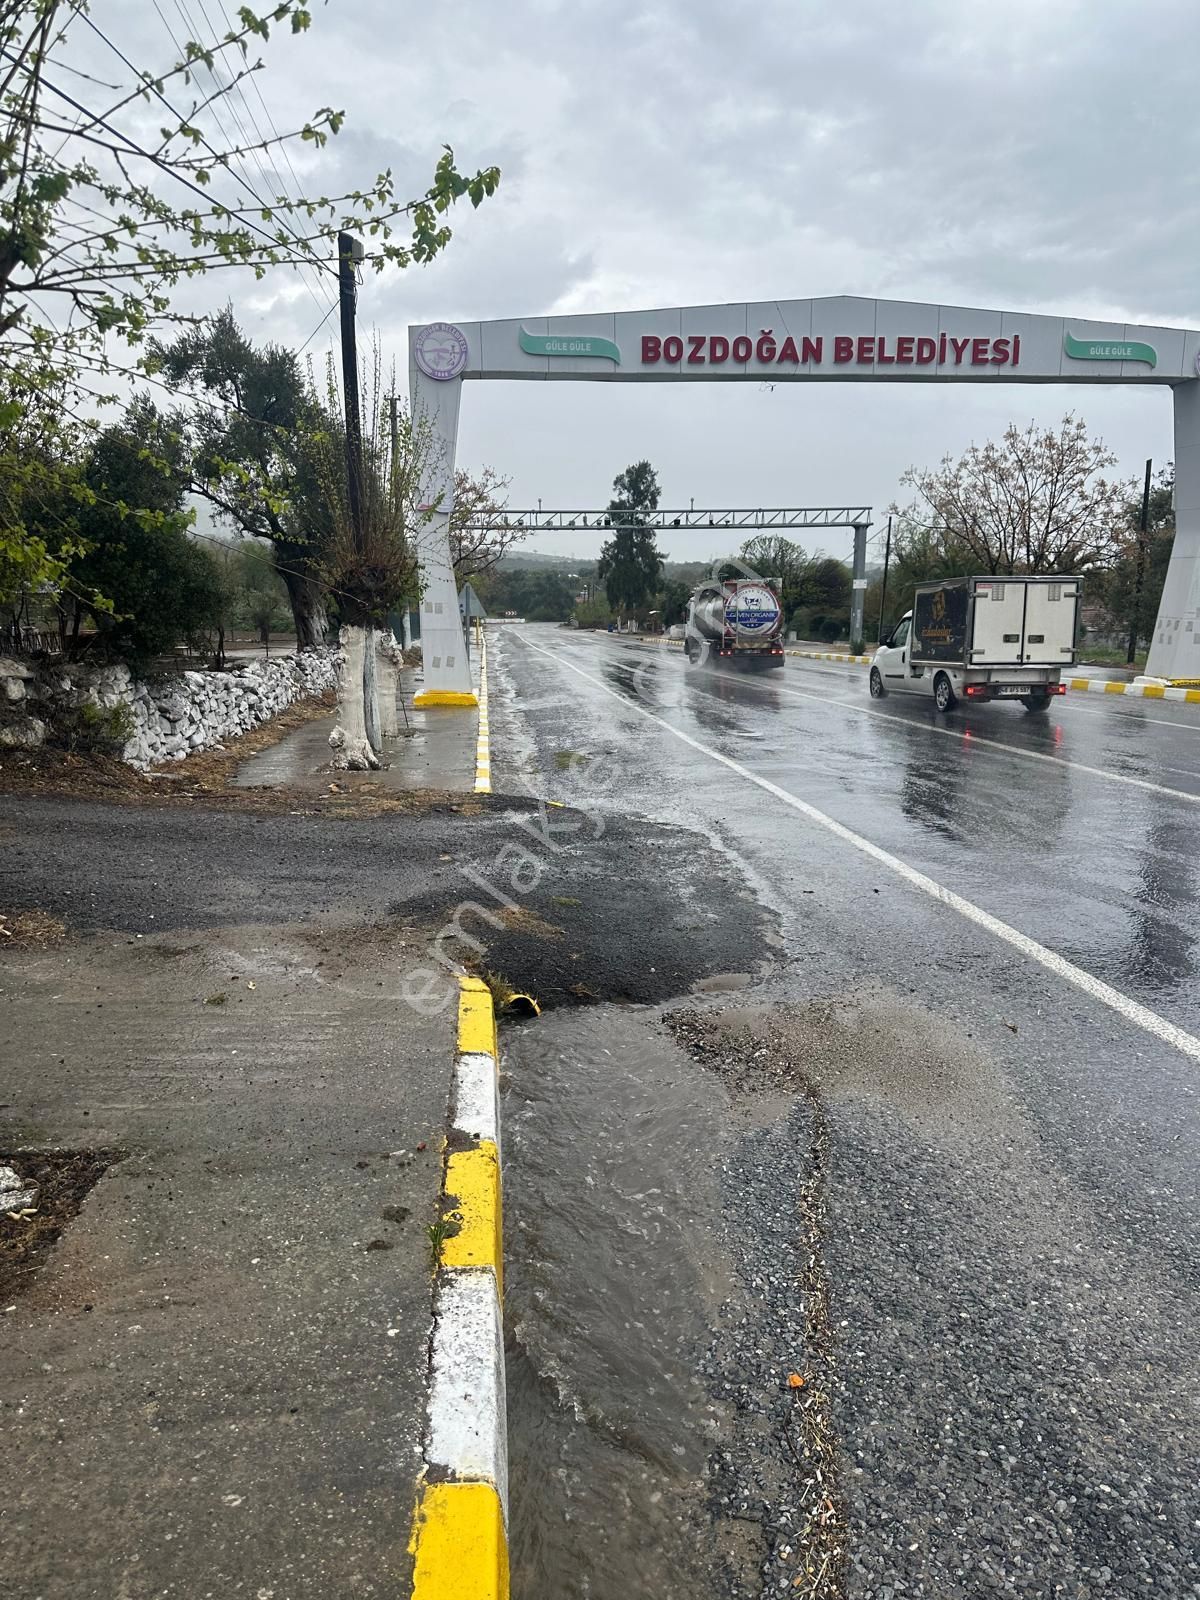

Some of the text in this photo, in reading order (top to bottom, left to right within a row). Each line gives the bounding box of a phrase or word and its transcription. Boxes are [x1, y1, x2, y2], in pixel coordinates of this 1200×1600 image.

[545, 340, 592, 351] GÜLE GÜLE
[641, 329, 1021, 365] BOZDOĞAN BELEDİYESİ
[1089, 345, 1133, 355] GÜLE GÜLE
